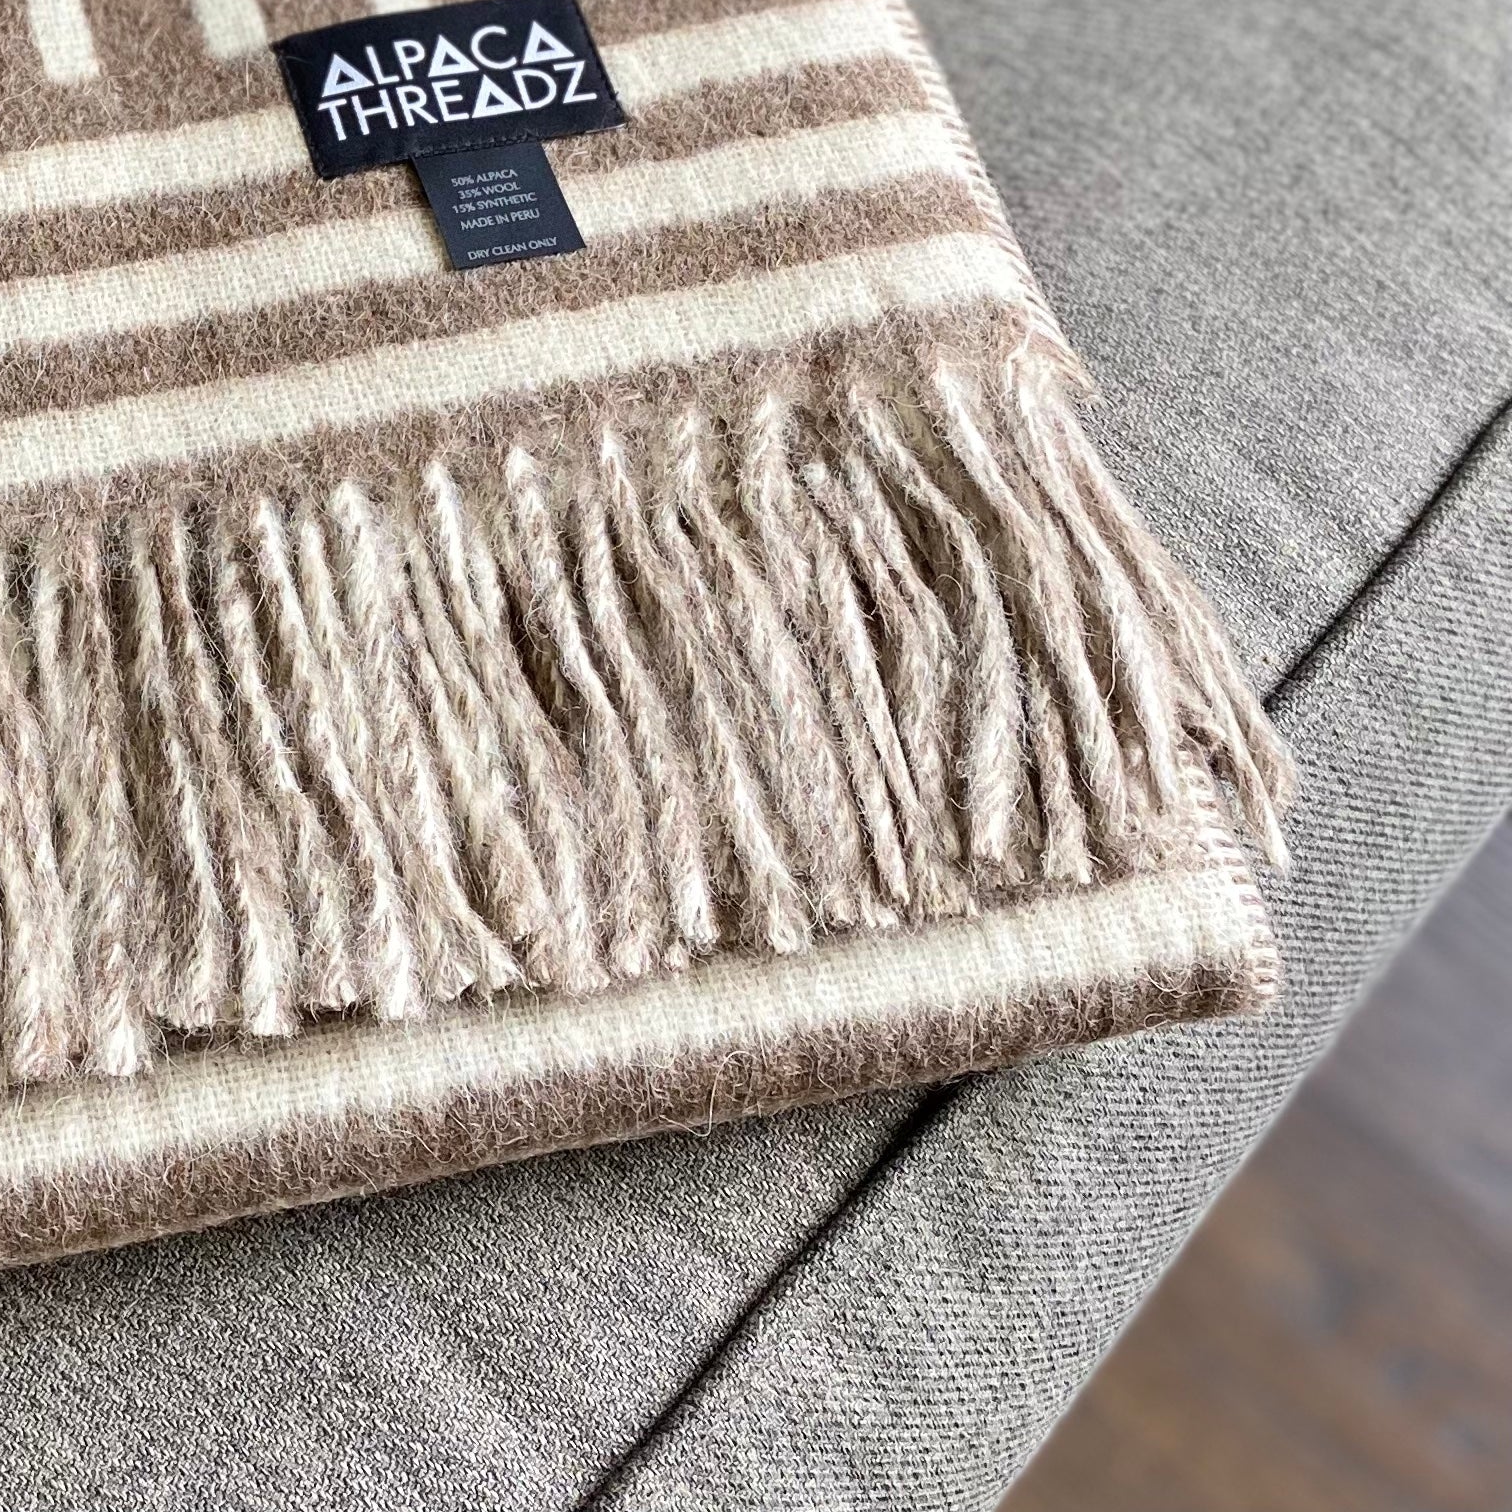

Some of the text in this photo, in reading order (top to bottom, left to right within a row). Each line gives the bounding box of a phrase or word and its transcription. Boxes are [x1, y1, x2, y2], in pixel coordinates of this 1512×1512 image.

[322, 21, 575, 97] ALPACA
[317, 60, 598, 141] THREADZ
[451, 169, 518, 187] 50% ALPACA
[458, 182, 521, 200] 35% WOOL
[452, 192, 538, 214] 15% SYNTHETIC
[460, 208, 540, 231] MADE IN PERU
[467, 237, 557, 260] DRY CLEAN ONLY
